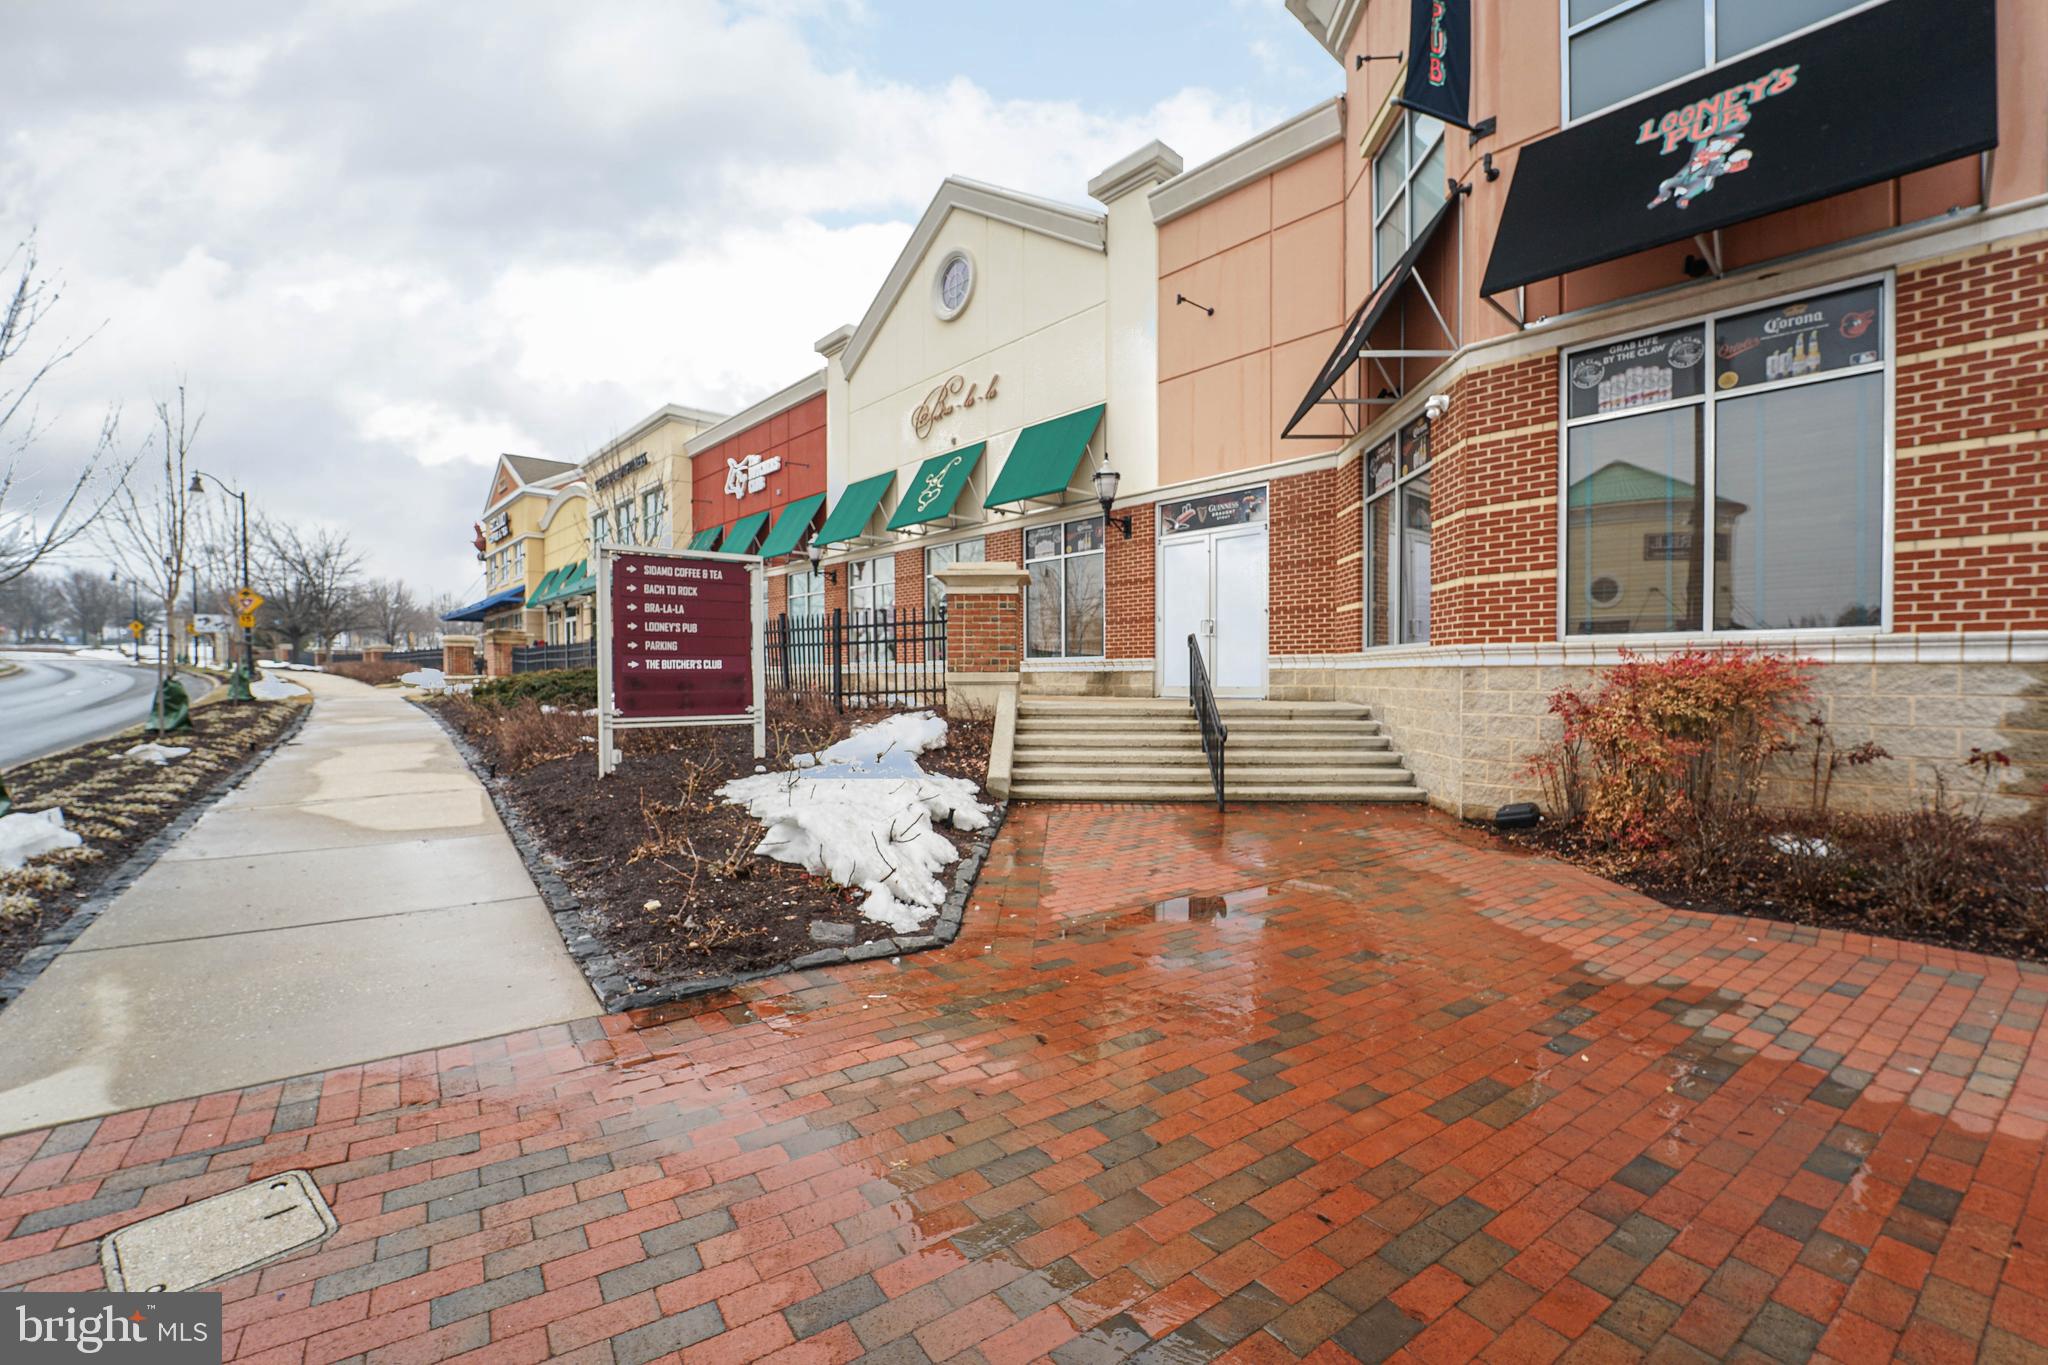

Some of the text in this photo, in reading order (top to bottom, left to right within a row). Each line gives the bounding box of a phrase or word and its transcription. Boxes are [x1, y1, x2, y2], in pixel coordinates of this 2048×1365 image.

[1429, 0, 1448, 87] PUB
[1635, 64, 1800, 145] LOONEY'S
[1659, 98, 1751, 155] PUB
[1763, 311, 1824, 334] Corona
[1609, 336, 1659, 354] GRAB LIFE
[1603, 343, 1666, 364] BY THE CLAW
[1208, 502, 1239, 512] GUINNESS
[643, 565, 723, 580] SIDAMO COFFEE & TEA
[643, 584, 698, 597] BACH TO ROCK
[644, 603, 685, 614] BRA-LA-LA
[644, 622, 698, 633] LOONEY'S PUB
[644, 641, 678, 651] PARKING
[645, 659, 723, 670] THE BUTCHER'S CLUB
